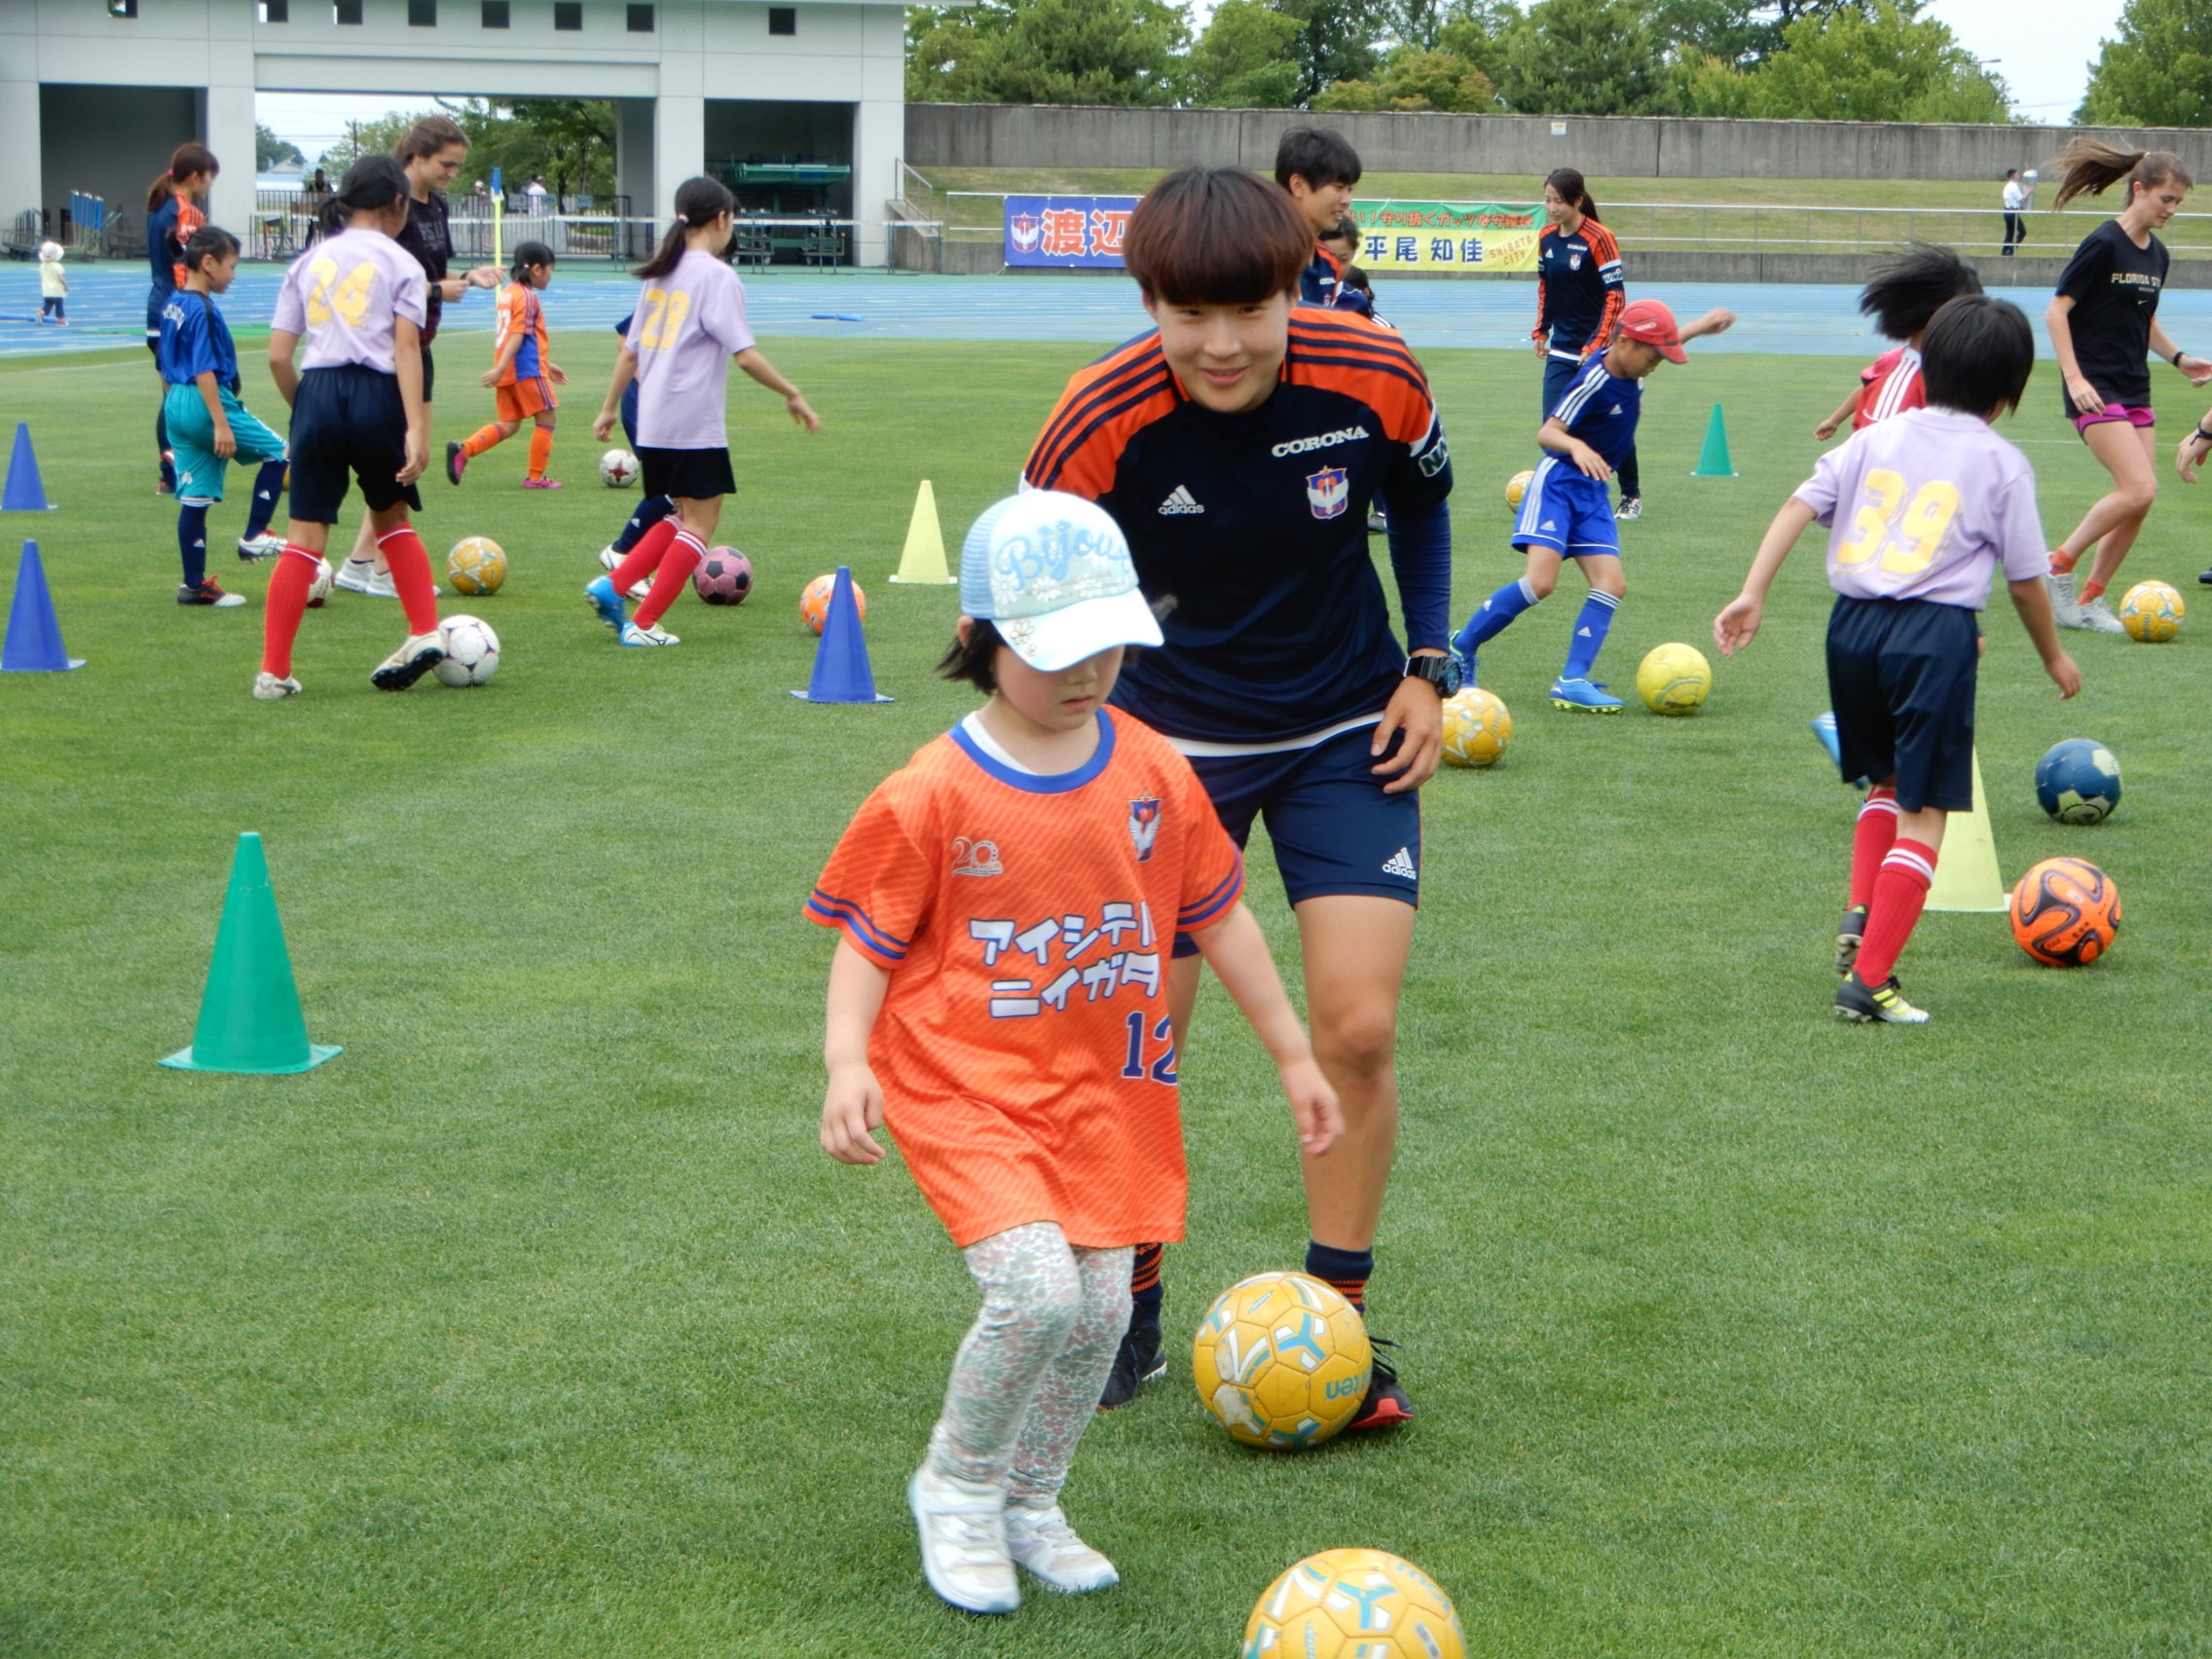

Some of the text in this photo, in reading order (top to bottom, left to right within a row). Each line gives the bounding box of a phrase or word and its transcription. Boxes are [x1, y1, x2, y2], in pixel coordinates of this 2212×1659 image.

[1490, 235, 1532, 259] SHIBATA
[1503, 250, 1526, 265] CITY
[307, 260, 378, 326] 24
[2111, 273, 2150, 285] FLORIDA
[1272, 425, 1369, 458] CORONA
[1159, 504, 1205, 516] adidas
[1836, 467, 1960, 576] 39
[1382, 864, 1417, 880] adidas
[989, 951, 1160, 1018] ニイガタ
[1122, 1011, 1178, 1086] 12
